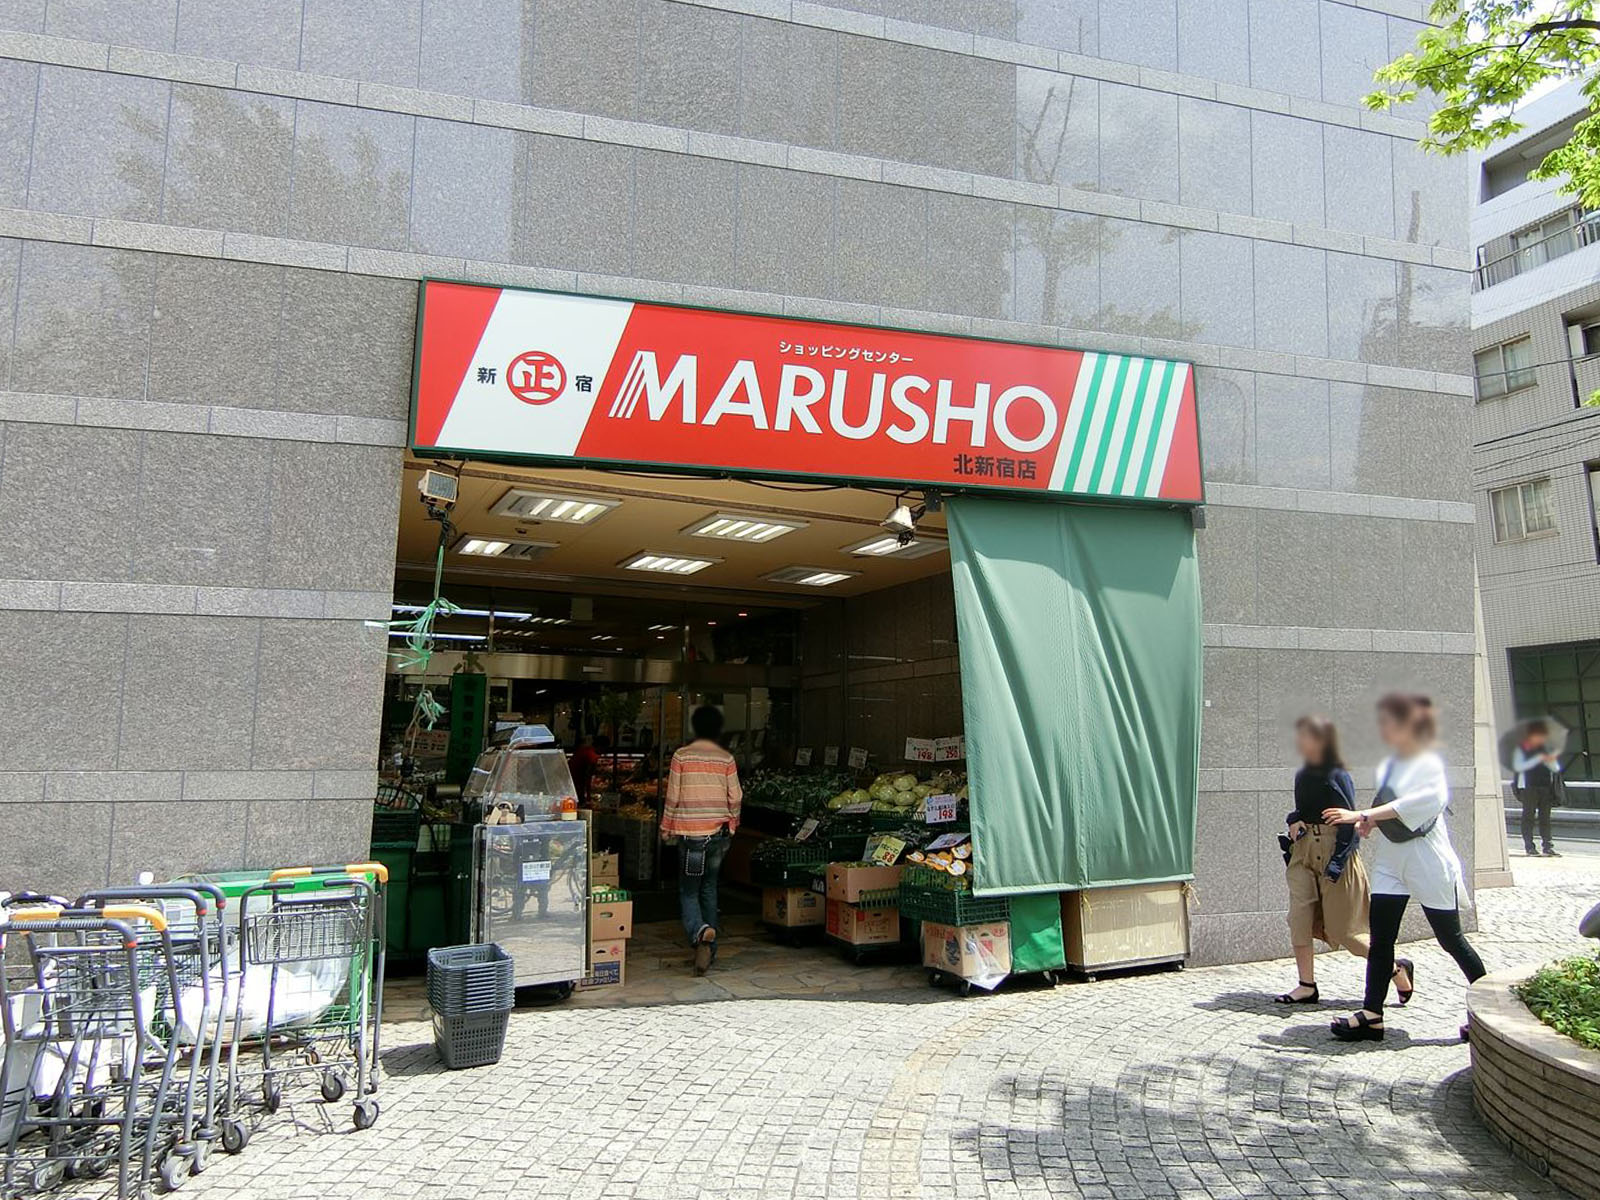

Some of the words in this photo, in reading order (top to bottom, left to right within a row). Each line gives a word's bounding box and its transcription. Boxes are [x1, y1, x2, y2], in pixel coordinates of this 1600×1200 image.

[779, 341, 914, 364] ショッピングセンター
[477, 367, 497, 385] 新
[575, 375, 593, 393] 宿
[608, 350, 1058, 453] MARUSHO
[953, 453, 1036, 480] 北新宿店
[939, 809, 953, 820] 198
[882, 851, 896, 863] 88
